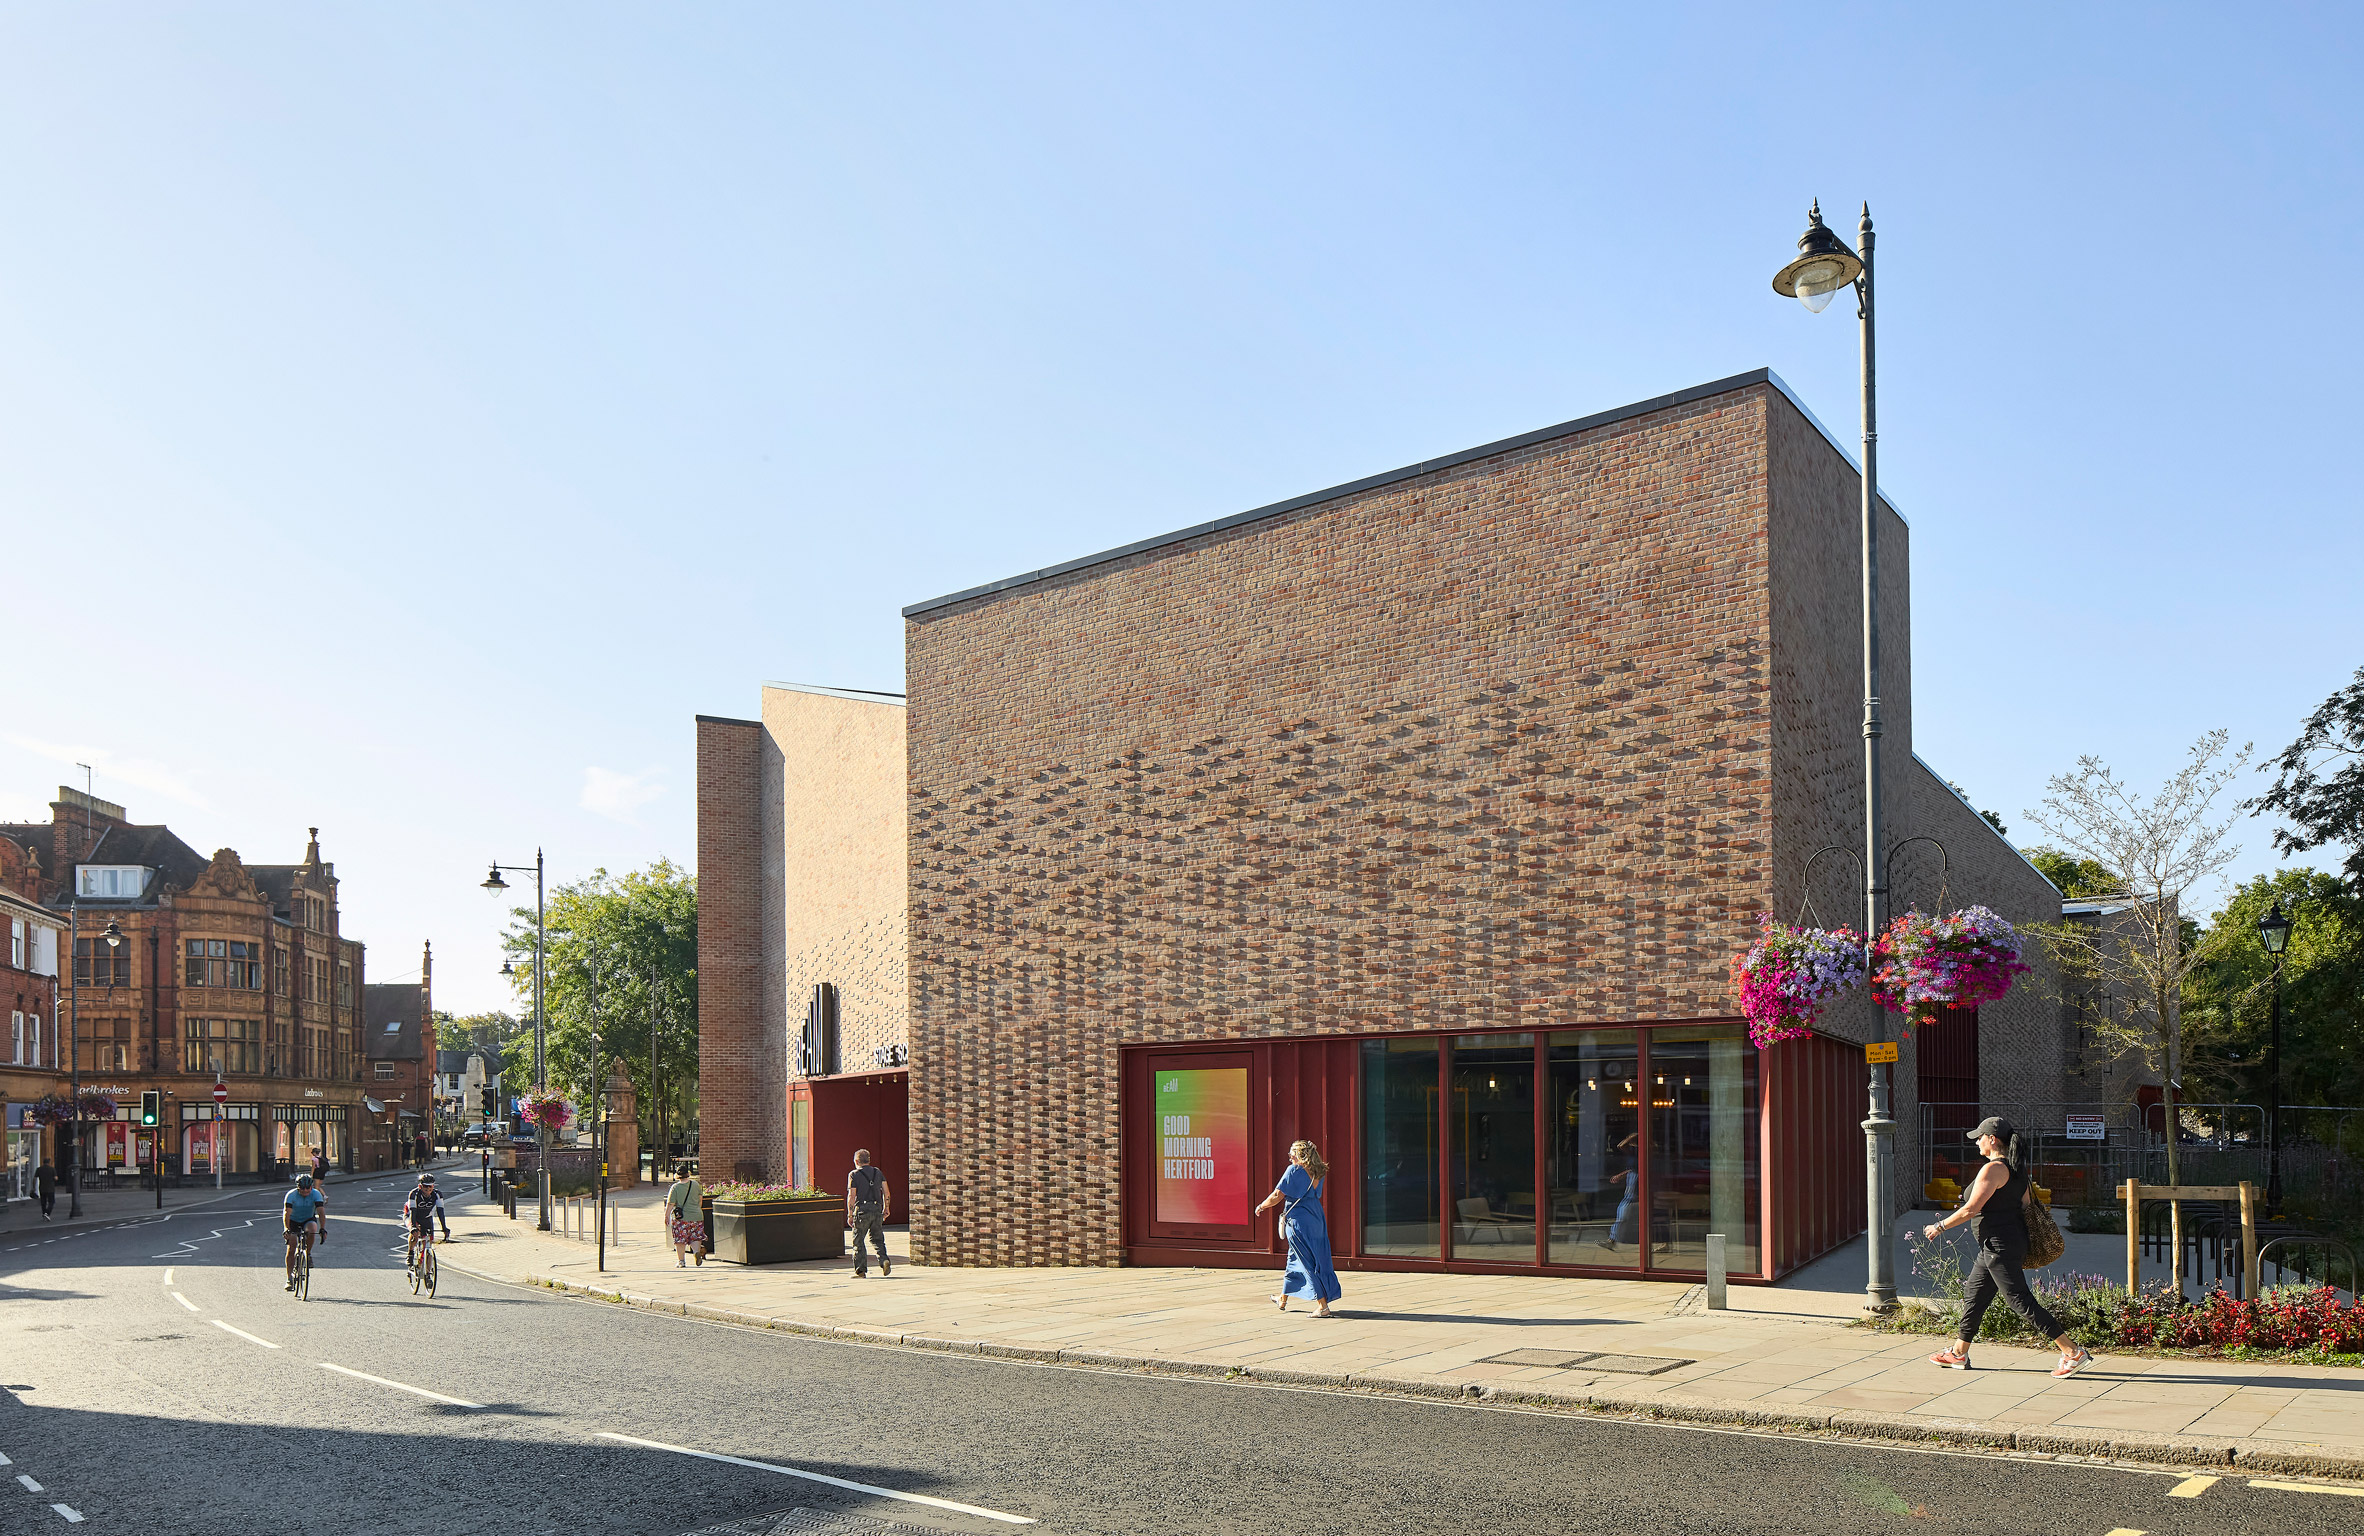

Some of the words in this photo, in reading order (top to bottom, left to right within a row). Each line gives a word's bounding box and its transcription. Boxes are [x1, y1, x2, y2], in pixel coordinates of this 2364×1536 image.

[796, 983, 828, 1076] BEAM
[874, 1045, 894, 1064] STAGE
[79, 1084, 130, 1095] adbrokes
[1163, 1078, 1178, 1092] BEAM
[1164, 1115, 1190, 1135] GOOD
[1164, 1137, 1212, 1157] MORNING
[1164, 1159, 1215, 1180] HERTFORD
